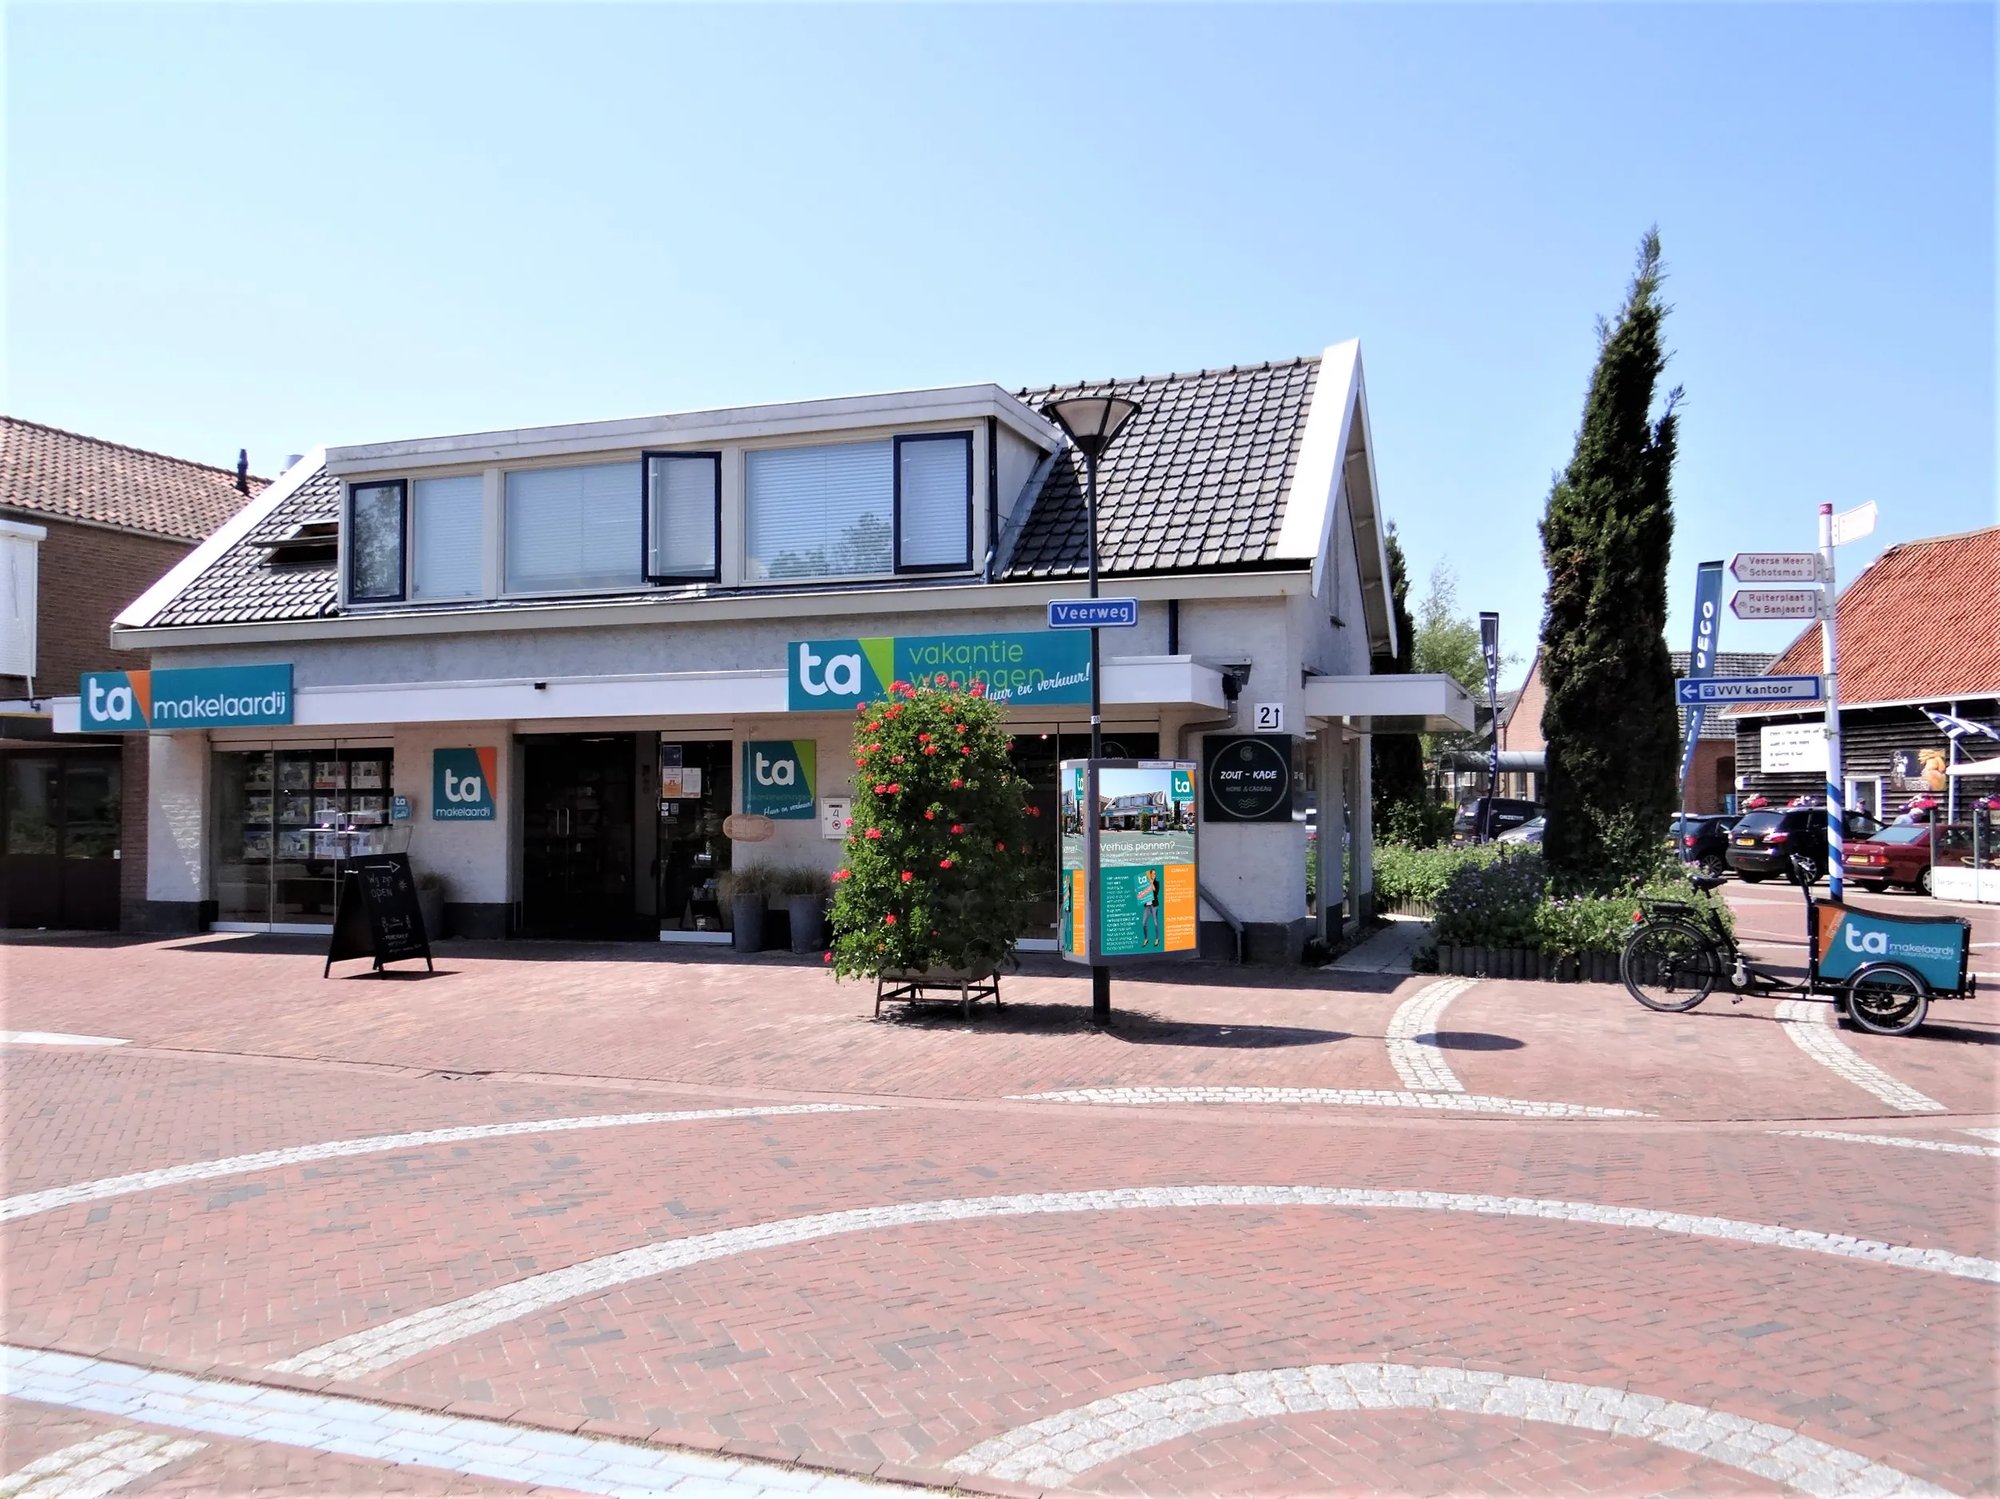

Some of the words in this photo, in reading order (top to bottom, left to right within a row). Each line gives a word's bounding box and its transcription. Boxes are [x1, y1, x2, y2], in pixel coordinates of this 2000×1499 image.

[1748, 557, 1779, 565] Veerse
[1783, 556, 1804, 565] Meer
[1749, 568, 1802, 577] Schotsman
[1748, 593, 1804, 603] Ruiterplaat
[1056, 605, 1129, 622] Veerweg
[1749, 605, 1762, 614] De
[1764, 605, 1805, 616] Banjaard
[799, 642, 862, 696] ta
[909, 640, 1024, 666] vakantie
[1017, 684, 1033, 696] en
[1037, 662, 1091, 692] verhuur!
[1717, 685, 1742, 695] VVV
[1745, 684, 1794, 696] kantoor
[88, 677, 132, 722] ta
[153, 691, 286, 720] makelaardij
[1260, 706, 1270, 724] 2
[755, 751, 795, 786] ta
[1220, 771, 1244, 780] ZOUT
[1252, 770, 1277, 780] KADE
[445, 768, 481, 803] ta
[1174, 777, 1190, 793] ta
[395, 797, 406, 806] ta
[436, 806, 490, 818] makelaardij
[1099, 842, 1133, 852] Verhuis
[1135, 841, 1176, 853] plannen?
[1845, 922, 1887, 955] ta
[1889, 943, 1954, 956] makelaardij
